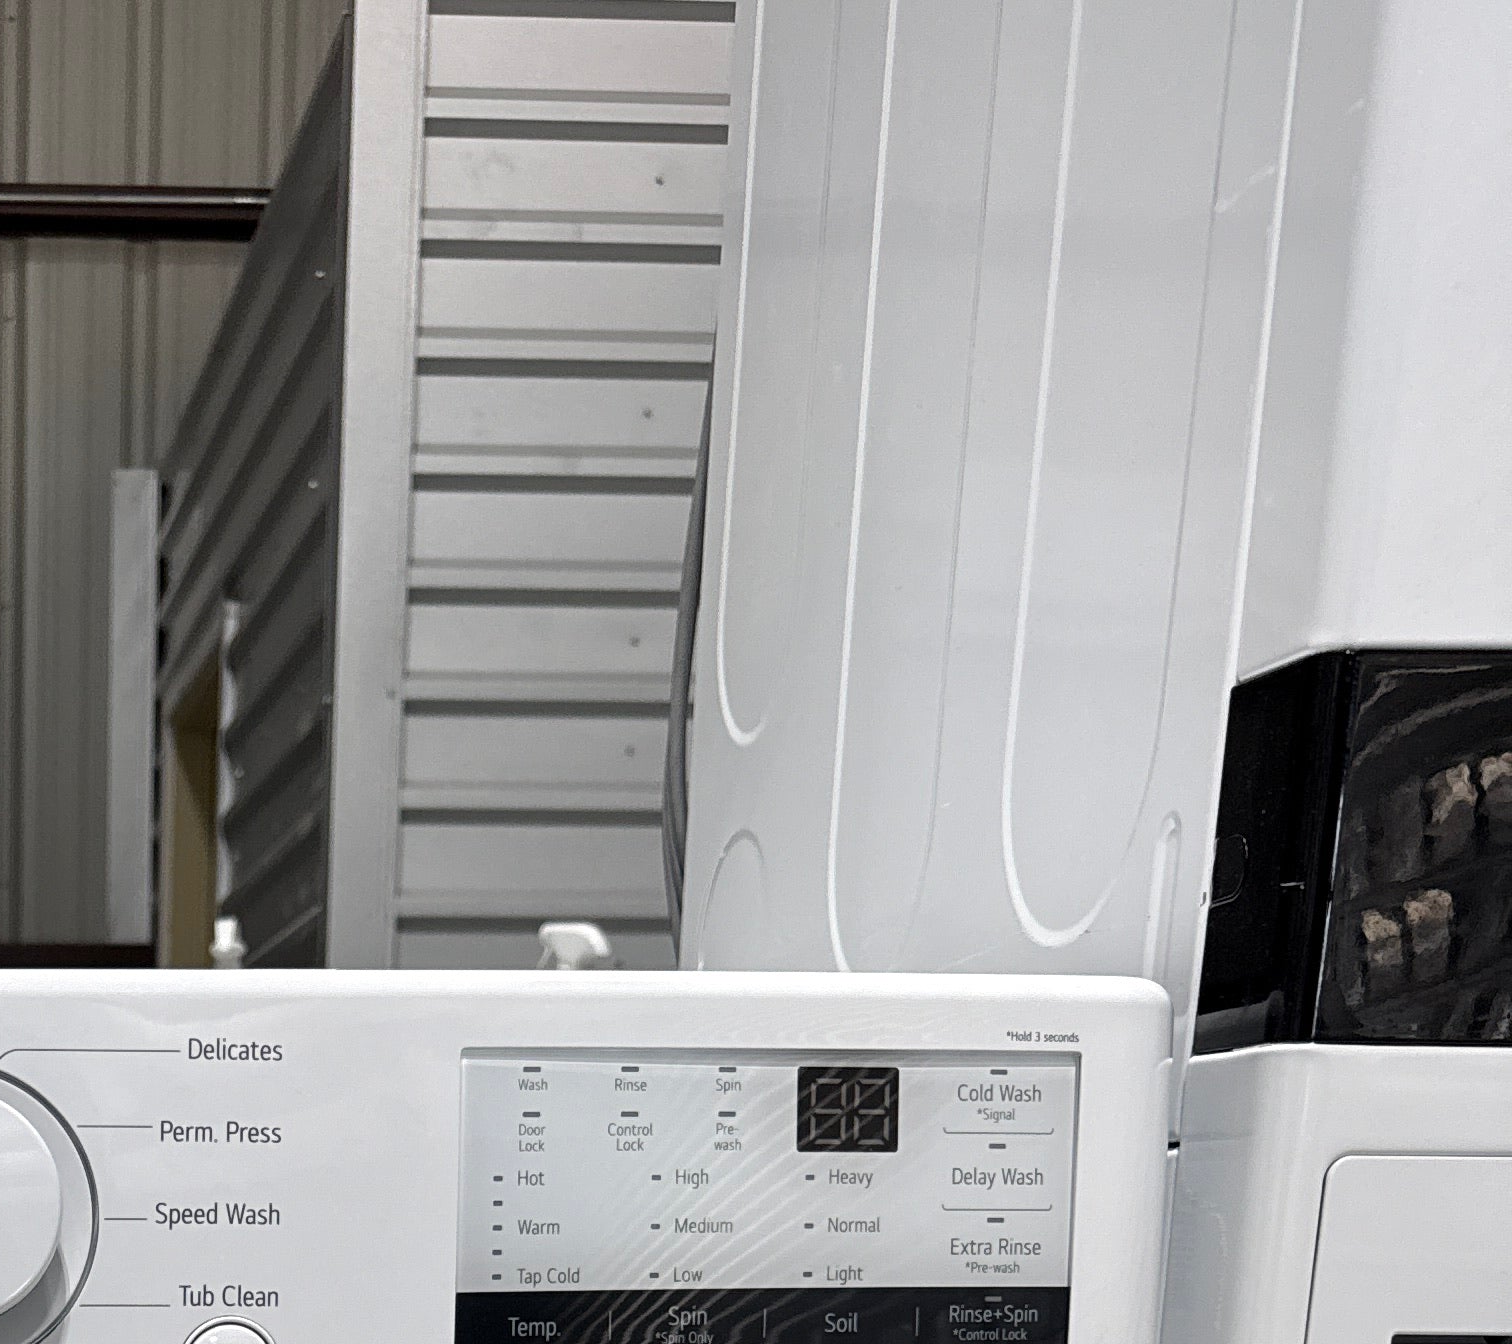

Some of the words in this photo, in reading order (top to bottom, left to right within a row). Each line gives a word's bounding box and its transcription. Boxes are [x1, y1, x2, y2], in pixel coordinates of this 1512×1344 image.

[1035, 1032, 1041, 1042] 3
[1043, 1032, 1080, 1043] seconds
[188, 1037, 283, 1061] Delicates
[518, 1078, 548, 1092] Wash
[614, 1078, 647, 1092] Rinse
[716, 1078, 742, 1095] Spin
[957, 1084, 994, 1102] Cold
[1000, 1084, 1042, 1102] Wash
[160, 1120, 218, 1143] Perm.
[226, 1120, 282, 1143] Press
[518, 1124, 546, 1136] Door
[607, 1123, 653, 1136] Control
[716, 1123, 739, 1135] Pre-
[519, 1140, 545, 1152] Lock
[616, 1138, 644, 1151] Lock
[714, 1139, 742, 1151] wash
[517, 1170, 545, 1186] Hot
[675, 1169, 709, 1189] High
[829, 1169, 873, 1189] Heavy
[952, 1167, 996, 1190] Delay
[1002, 1168, 1044, 1185] Wash
[155, 1202, 218, 1230] Speed
[226, 1202, 280, 1225] Wash
[518, 1219, 560, 1235] Warm
[674, 1217, 733, 1234] Medium
[827, 1217, 881, 1233] Normal
[950, 1238, 992, 1255] Extra
[998, 1238, 1041, 1255] Rinse
[517, 1268, 542, 1287] Tap
[547, 1267, 580, 1284] Cold
[673, 1267, 703, 1283] Low
[826, 1265, 863, 1285] Light
[179, 1284, 214, 1307] Tub
[222, 1284, 279, 1307] Clean
[668, 1305, 708, 1328] Spin
[824, 1312, 858, 1333] Soil
[949, 1304, 1038, 1327] Rinse+Spin
[508, 1317, 562, 1342] Temp.
[1002, 1328, 1028, 1340] Lock
